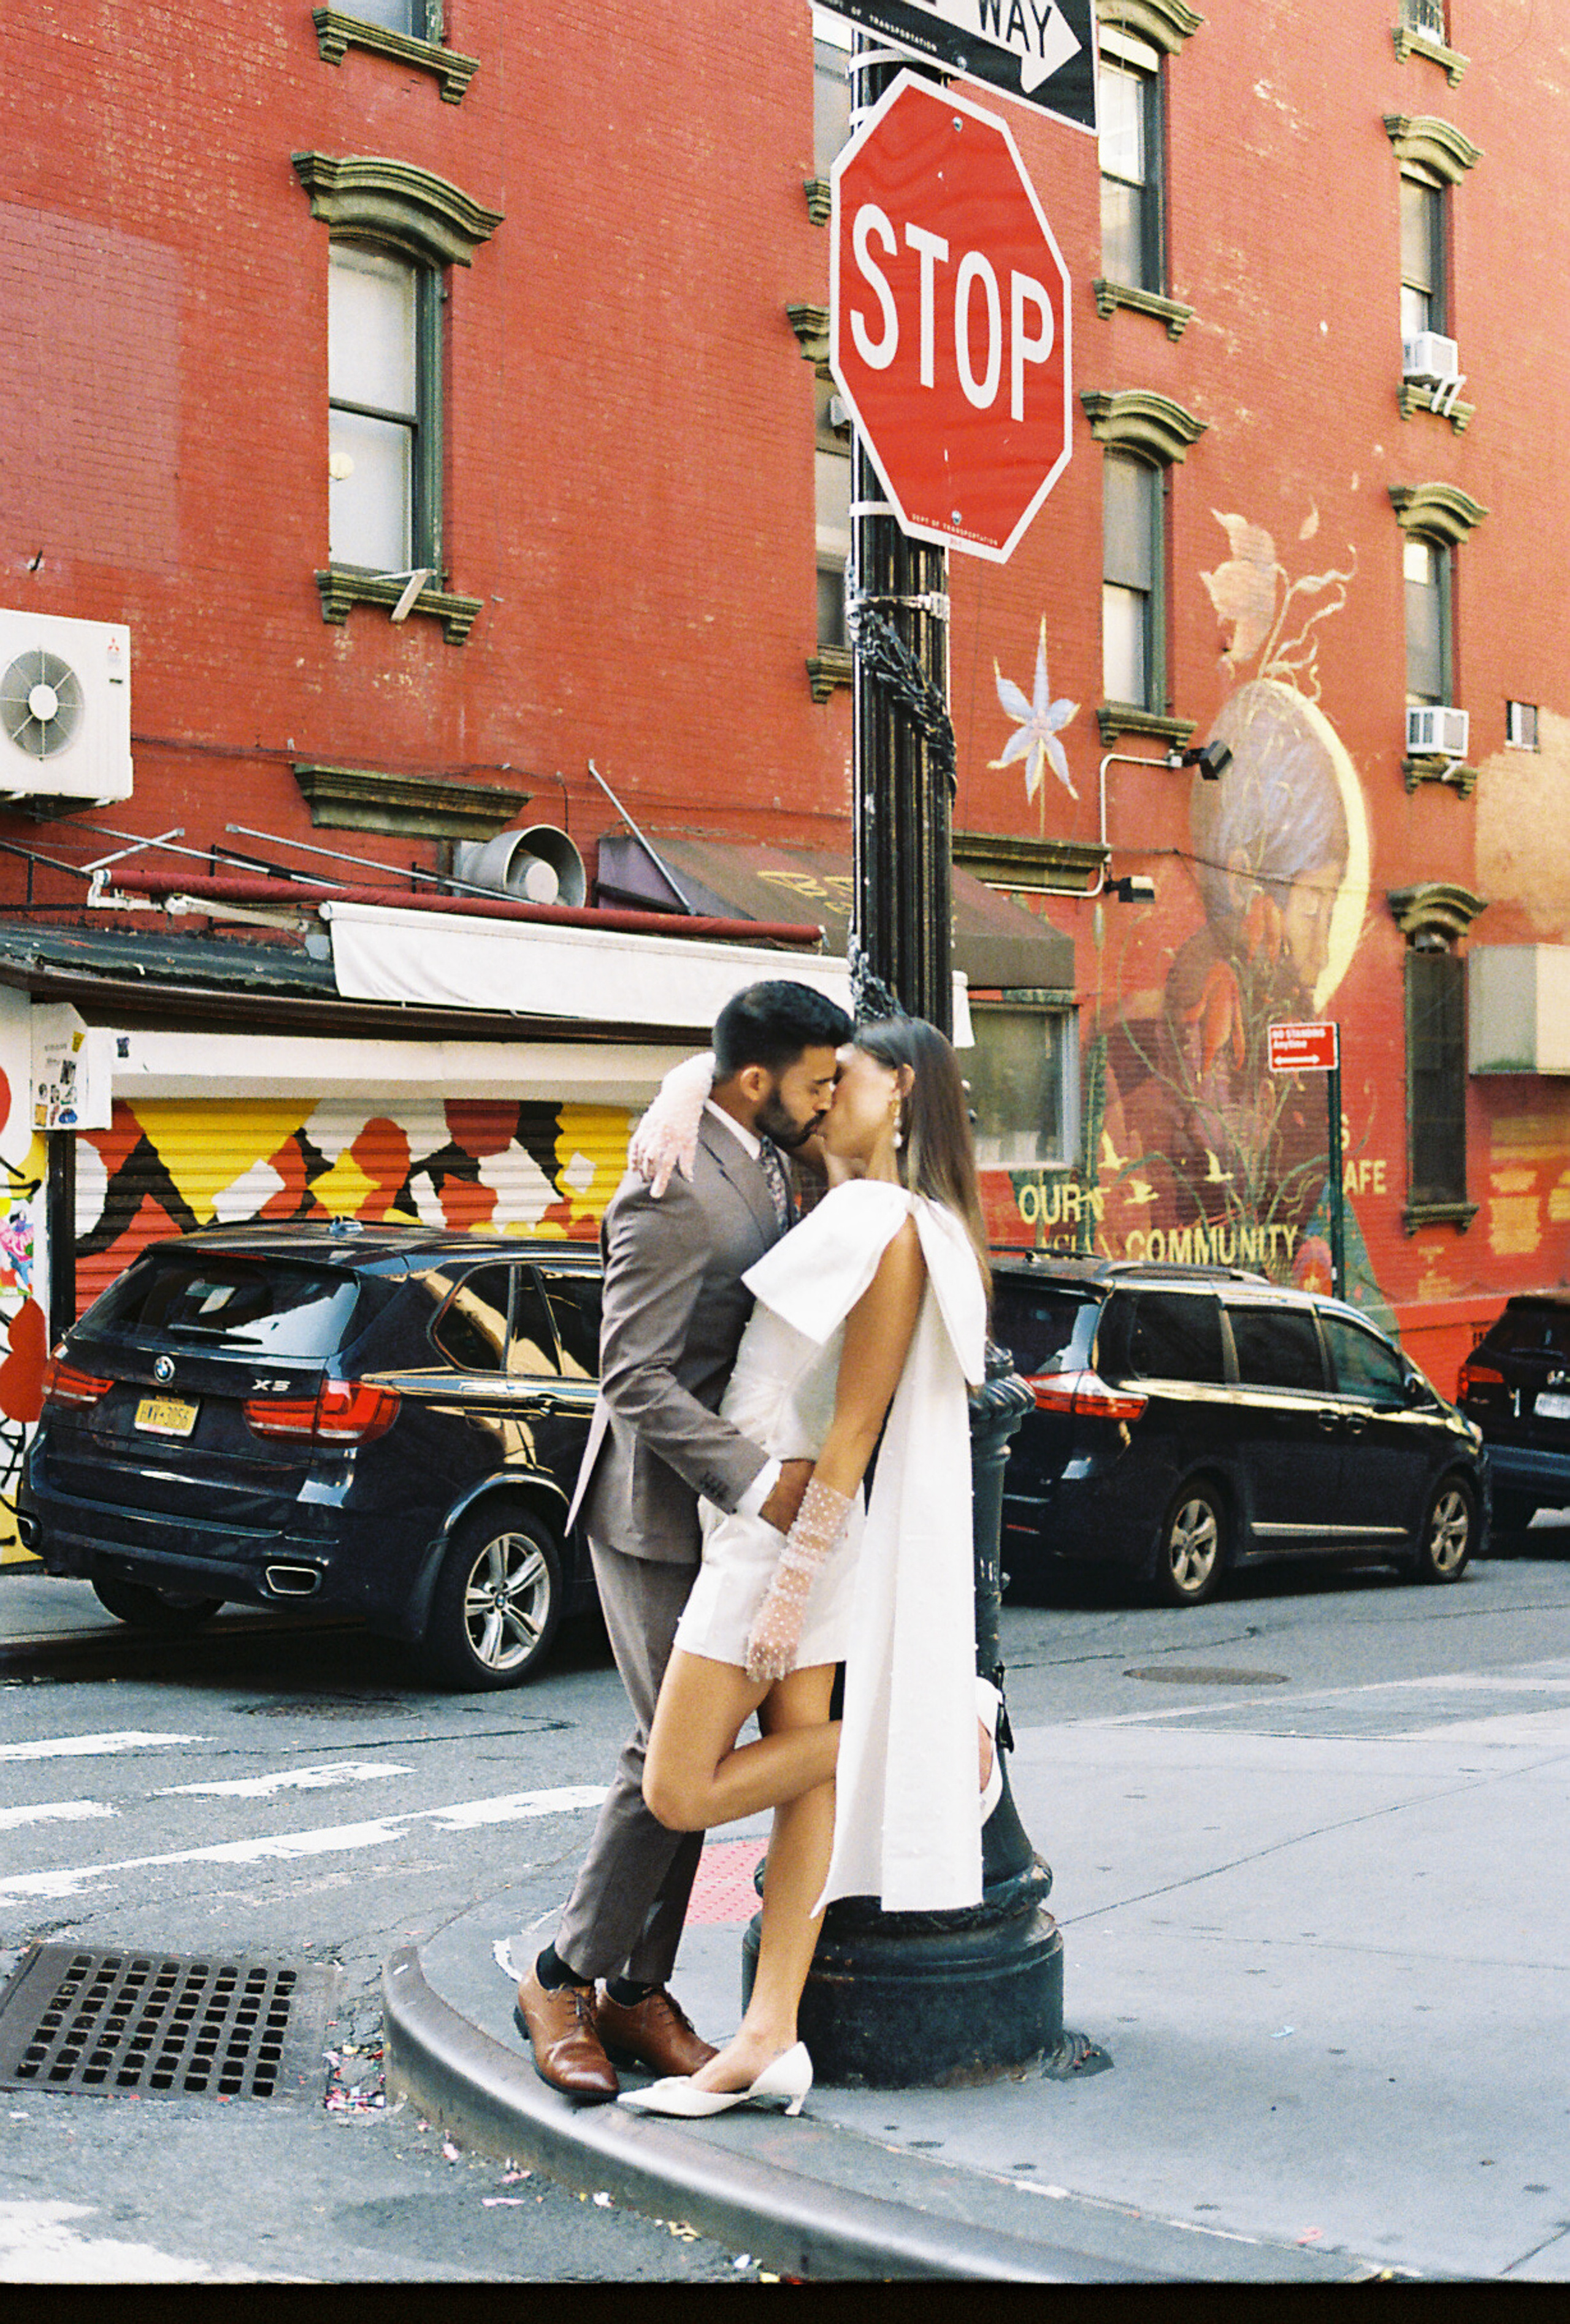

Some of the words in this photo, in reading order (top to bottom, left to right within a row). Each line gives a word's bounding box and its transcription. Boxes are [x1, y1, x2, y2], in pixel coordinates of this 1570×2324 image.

[869, 13, 937, 52] TRANSPORTATION
[979, 0, 1052, 58] WAY
[850, 204, 1054, 422] STOP
[912, 513, 929, 524] DEPT
[943, 522, 998, 546] TRANSPORTATION
[1273, 1030, 1284, 1039] NO
[1286, 1028, 1326, 1039] STANDING
[1273, 1040, 1308, 1051] Anytime
[1342, 1159, 1387, 1194] AFE
[1019, 1184, 1081, 1225] OUR
[1125, 1225, 1299, 1265] COMMUNITY
[252, 1379, 291, 1391] X5
